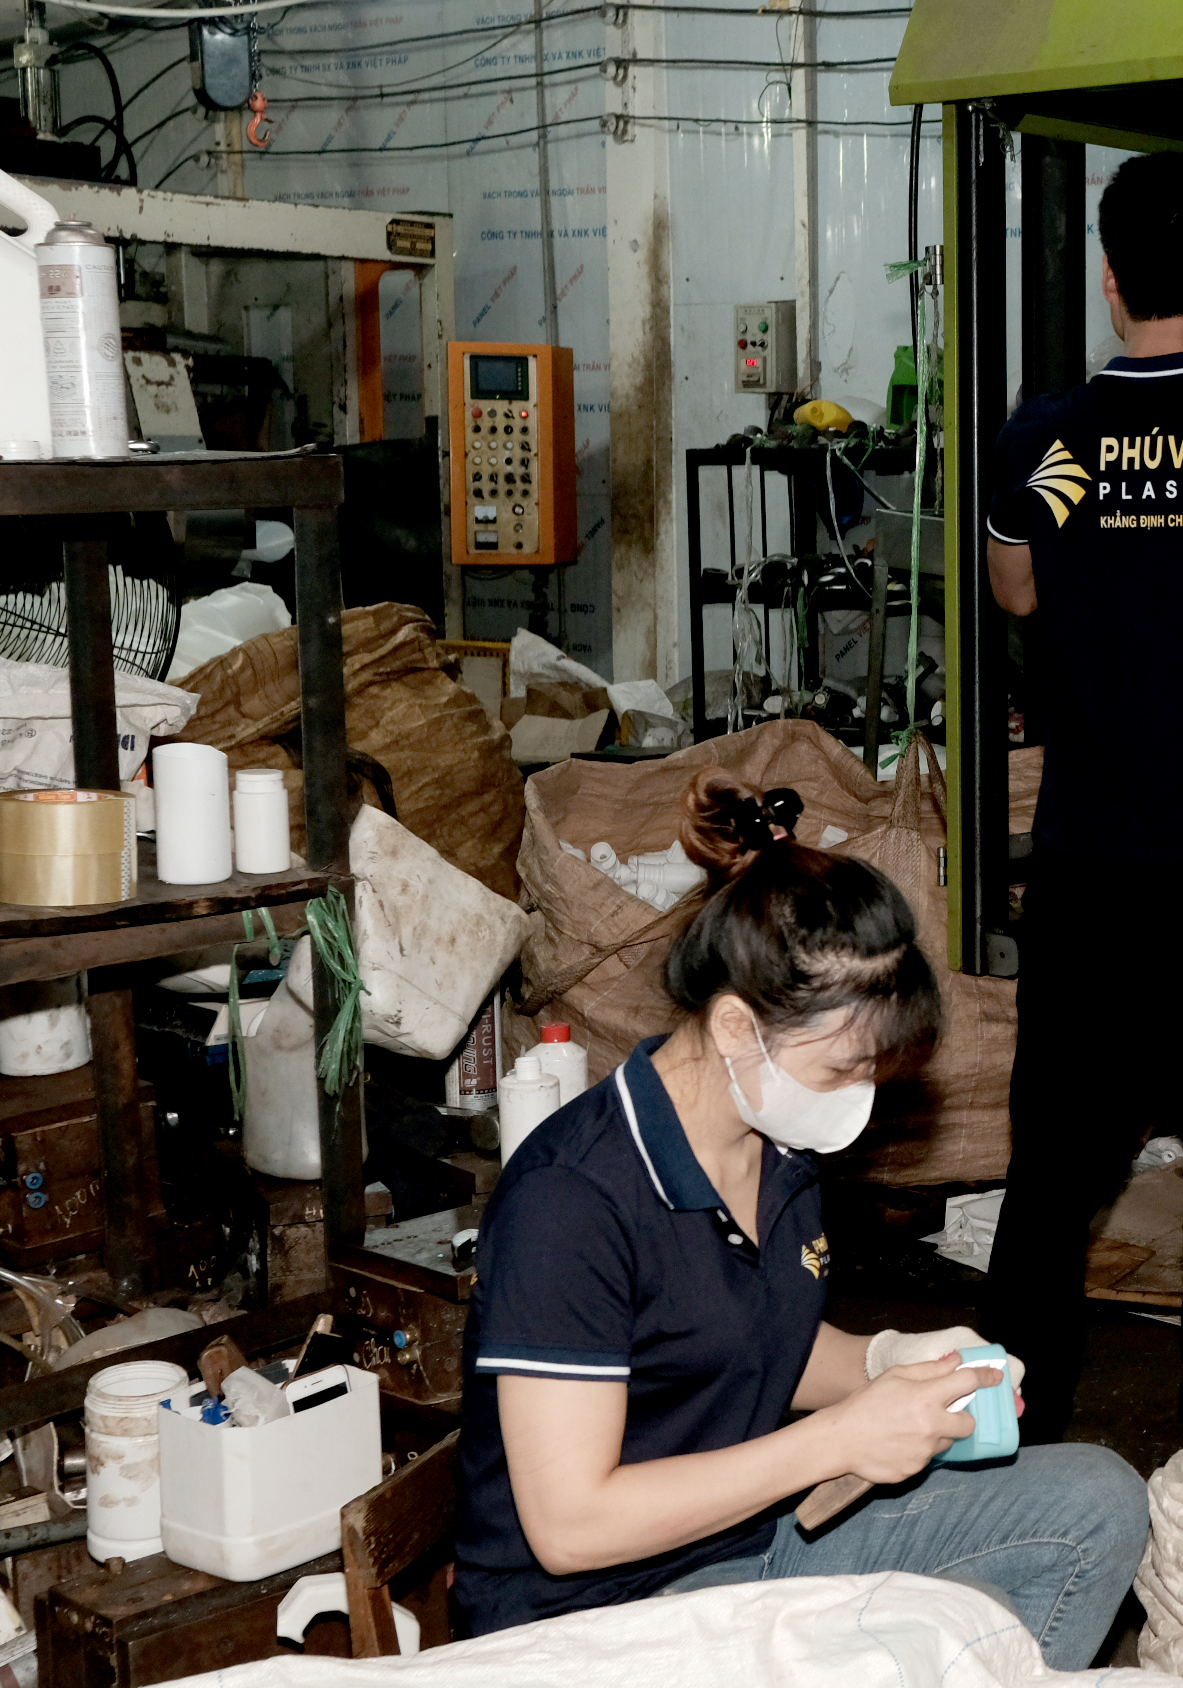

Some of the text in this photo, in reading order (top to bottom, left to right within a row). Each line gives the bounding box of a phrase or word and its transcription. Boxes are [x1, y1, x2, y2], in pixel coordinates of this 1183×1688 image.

[480, 227, 505, 242] CÔNG
[506, 229, 517, 240] TY
[571, 226, 590, 239] XNK
[577, 402, 596, 413] XNK
[1100, 427, 1163, 471] PHÚ
[1100, 509, 1137, 528] KHẲNG
[1140, 514, 1165, 530] ĐỊNH
[834, 637, 859, 664] PANEL
